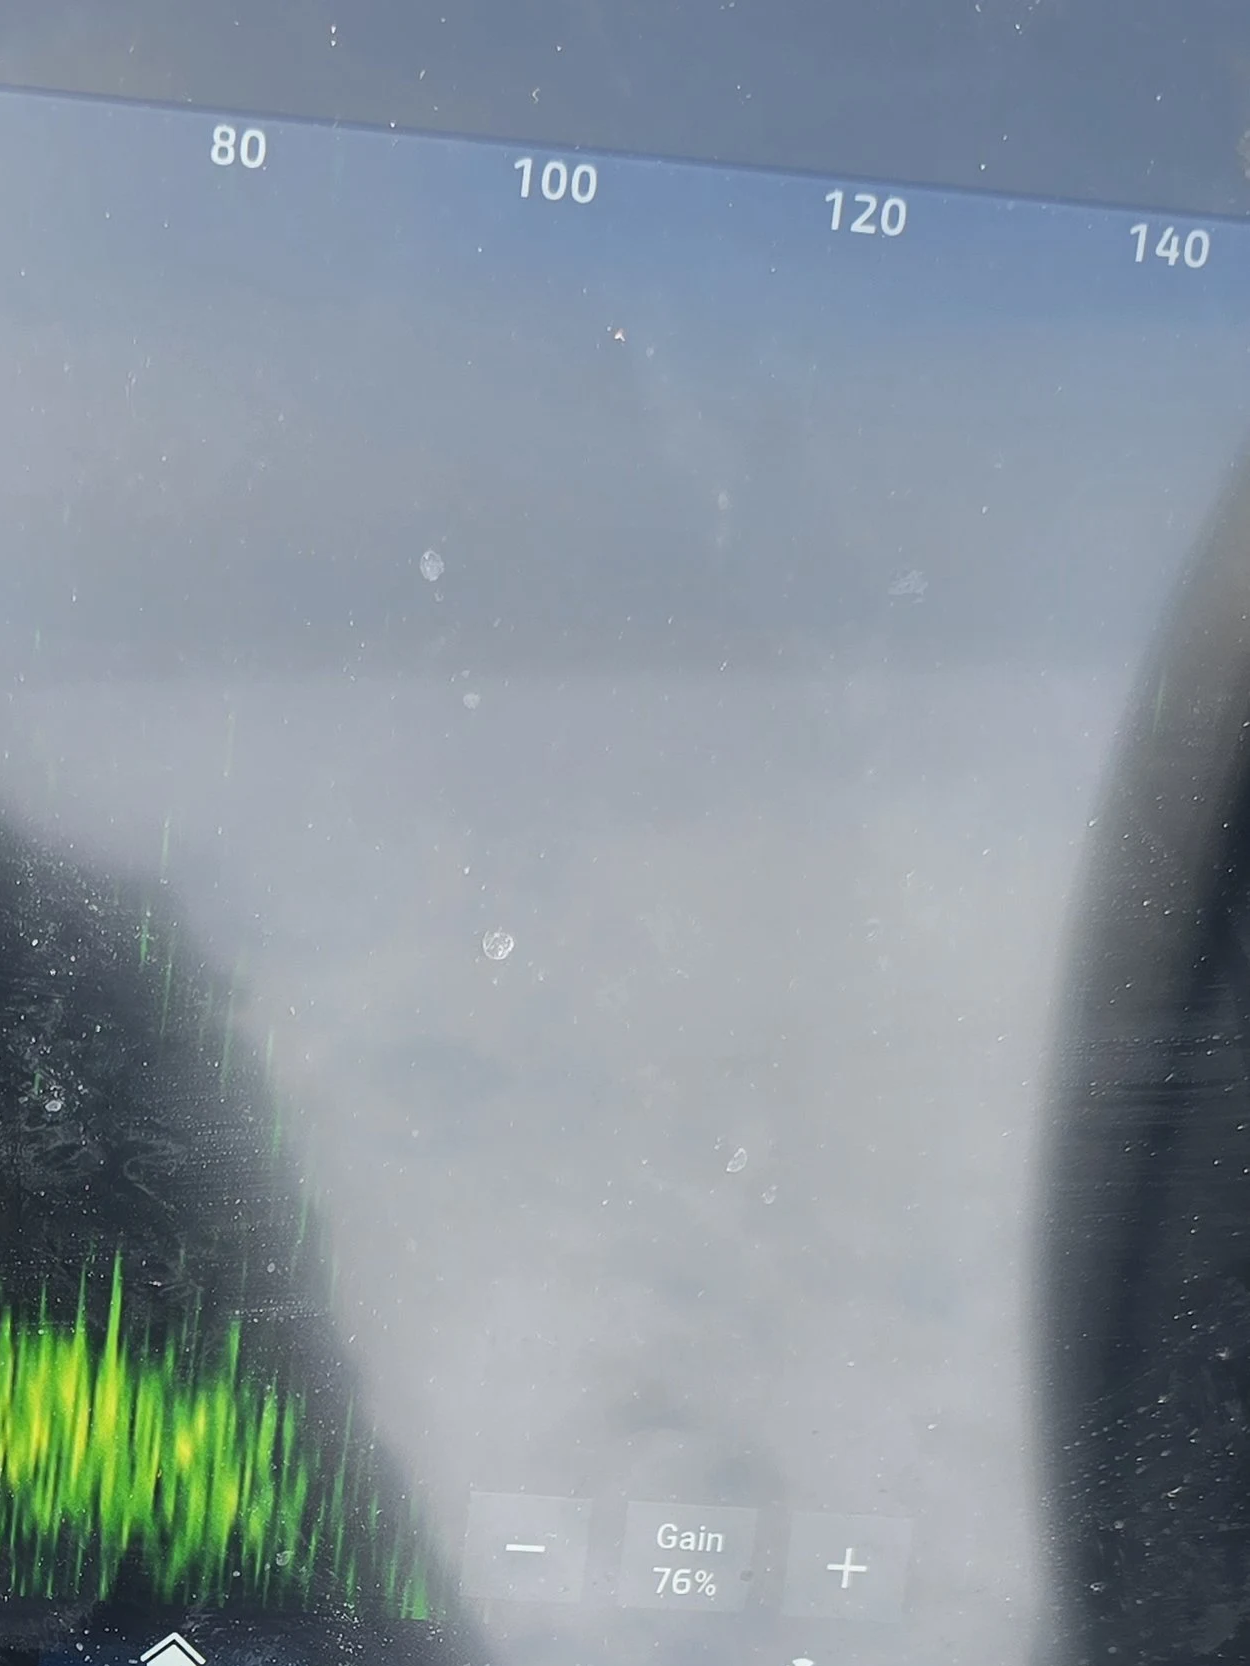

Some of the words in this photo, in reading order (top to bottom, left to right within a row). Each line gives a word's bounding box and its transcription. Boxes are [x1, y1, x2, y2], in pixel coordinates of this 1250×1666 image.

[210, 124, 267, 168] 80
[512, 158, 598, 205] 100
[824, 189, 907, 237] 120
[1129, 222, 1211, 270] 140
[656, 1522, 724, 1553] Gain
[652, 1566, 716, 1597] 76%
